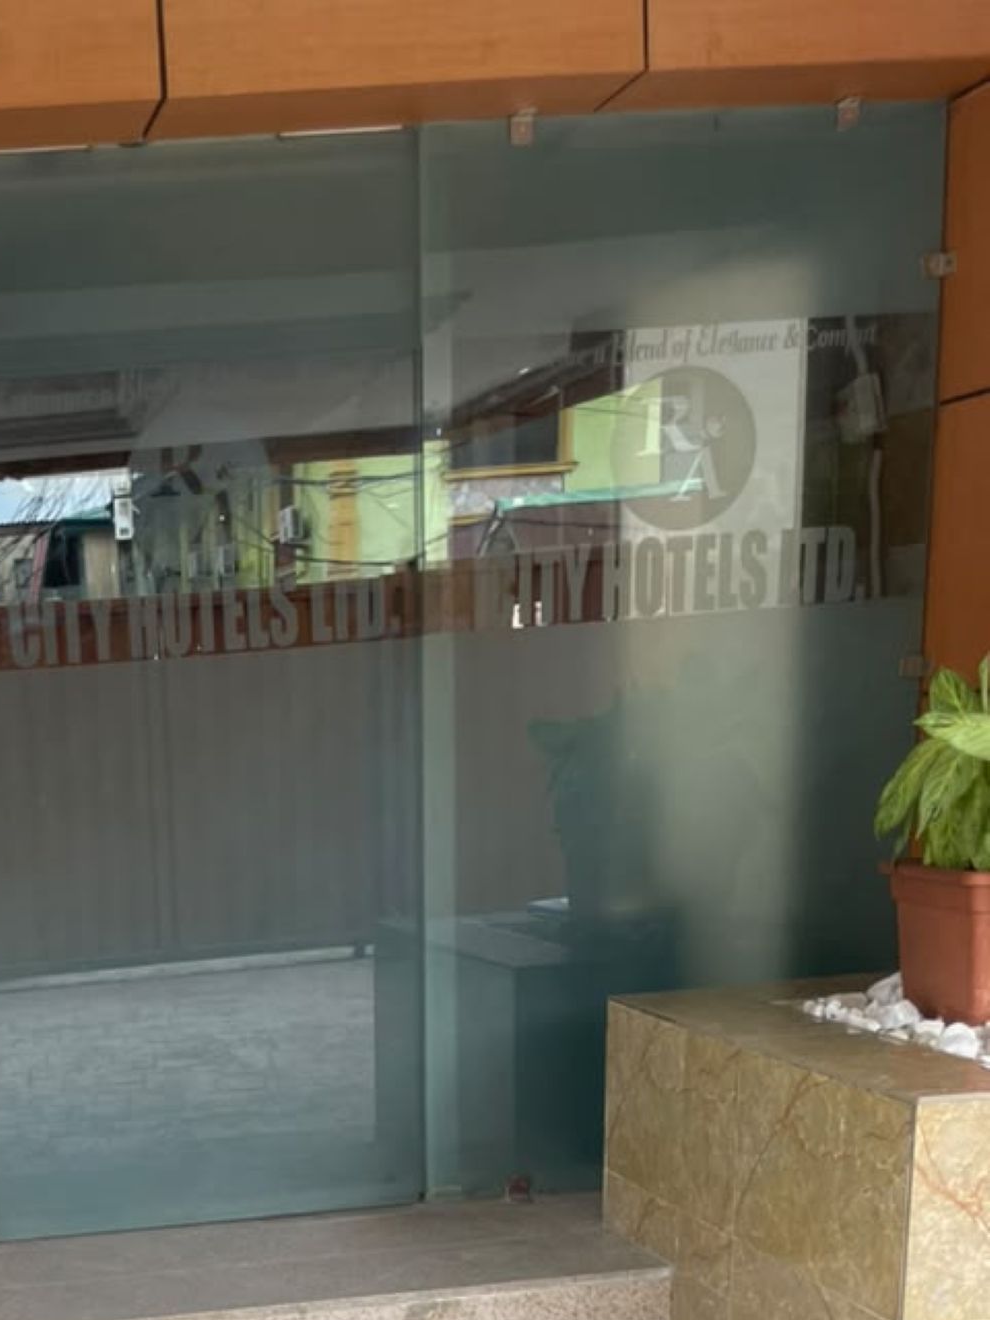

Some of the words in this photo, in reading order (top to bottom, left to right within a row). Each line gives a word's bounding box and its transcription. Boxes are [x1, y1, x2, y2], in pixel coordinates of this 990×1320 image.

[672, 326, 694, 363] of
[783, 325, 802, 350] &
[602, 528, 769, 621] HOTELS
[778, 525, 868, 608] LTD.
[8, 594, 115, 669] CITY
[126, 580, 300, 660] HOTELS
[310, 574, 401, 644] LTD.
